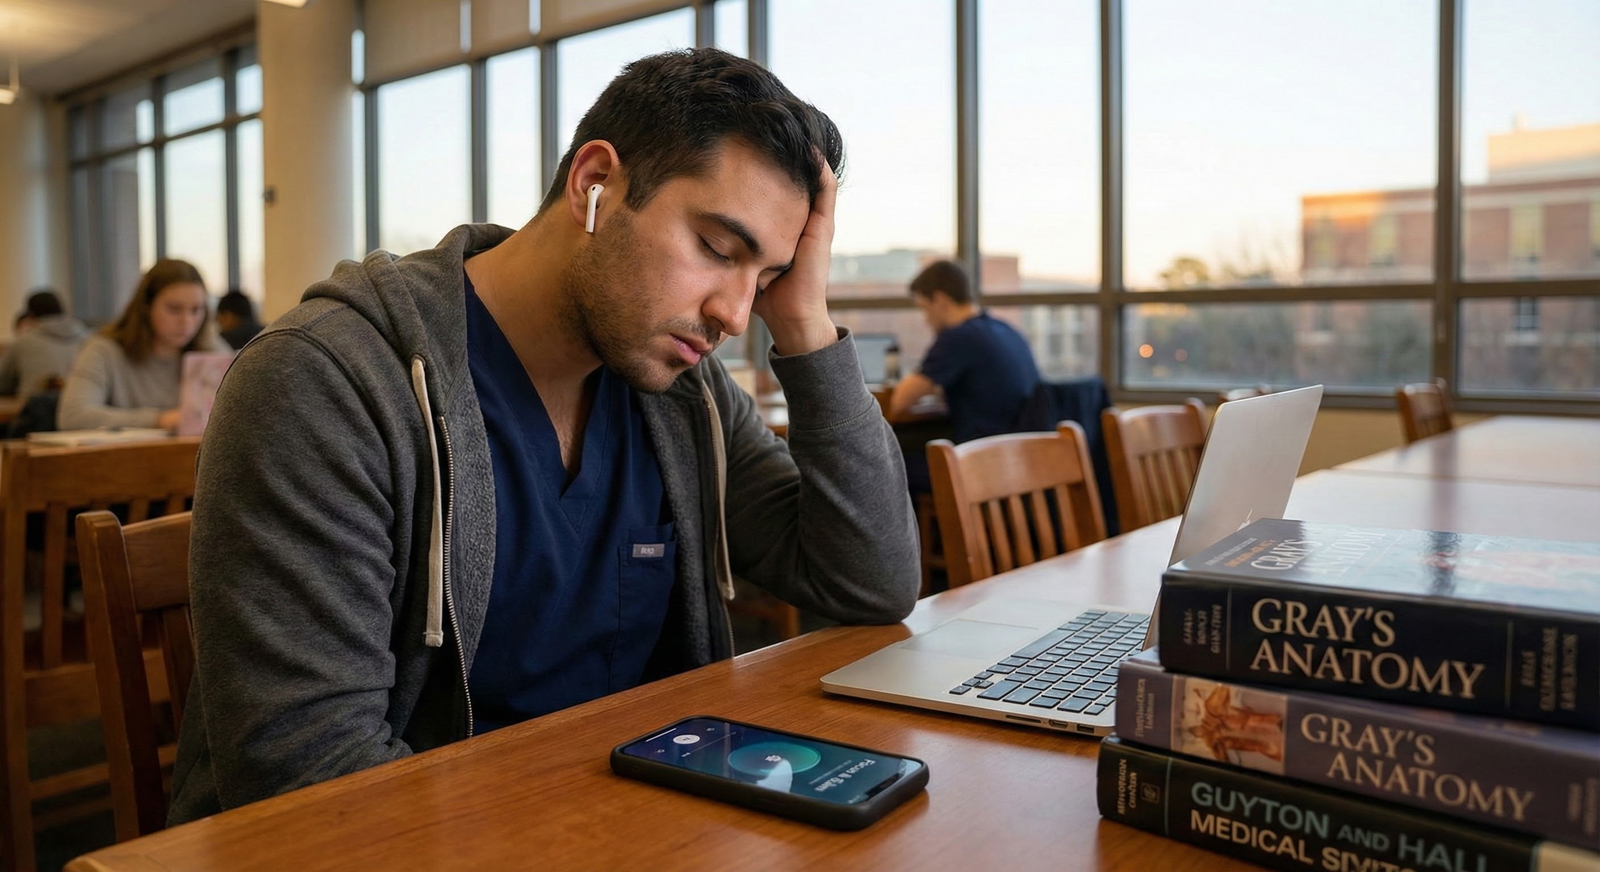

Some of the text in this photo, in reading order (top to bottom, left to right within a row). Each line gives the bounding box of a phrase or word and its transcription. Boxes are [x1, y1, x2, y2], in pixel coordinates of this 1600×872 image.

[1251, 598, 1396, 647] GRAY'S
[1250, 639, 1486, 699] ANATOMY
[1300, 713, 1436, 766] GRAY'S
[1326, 752, 1535, 822] ANATOMY
[1190, 809, 1314, 864] MEDICAL
[1191, 782, 1329, 839] GUYTON
[1337, 824, 1390, 852] AND
